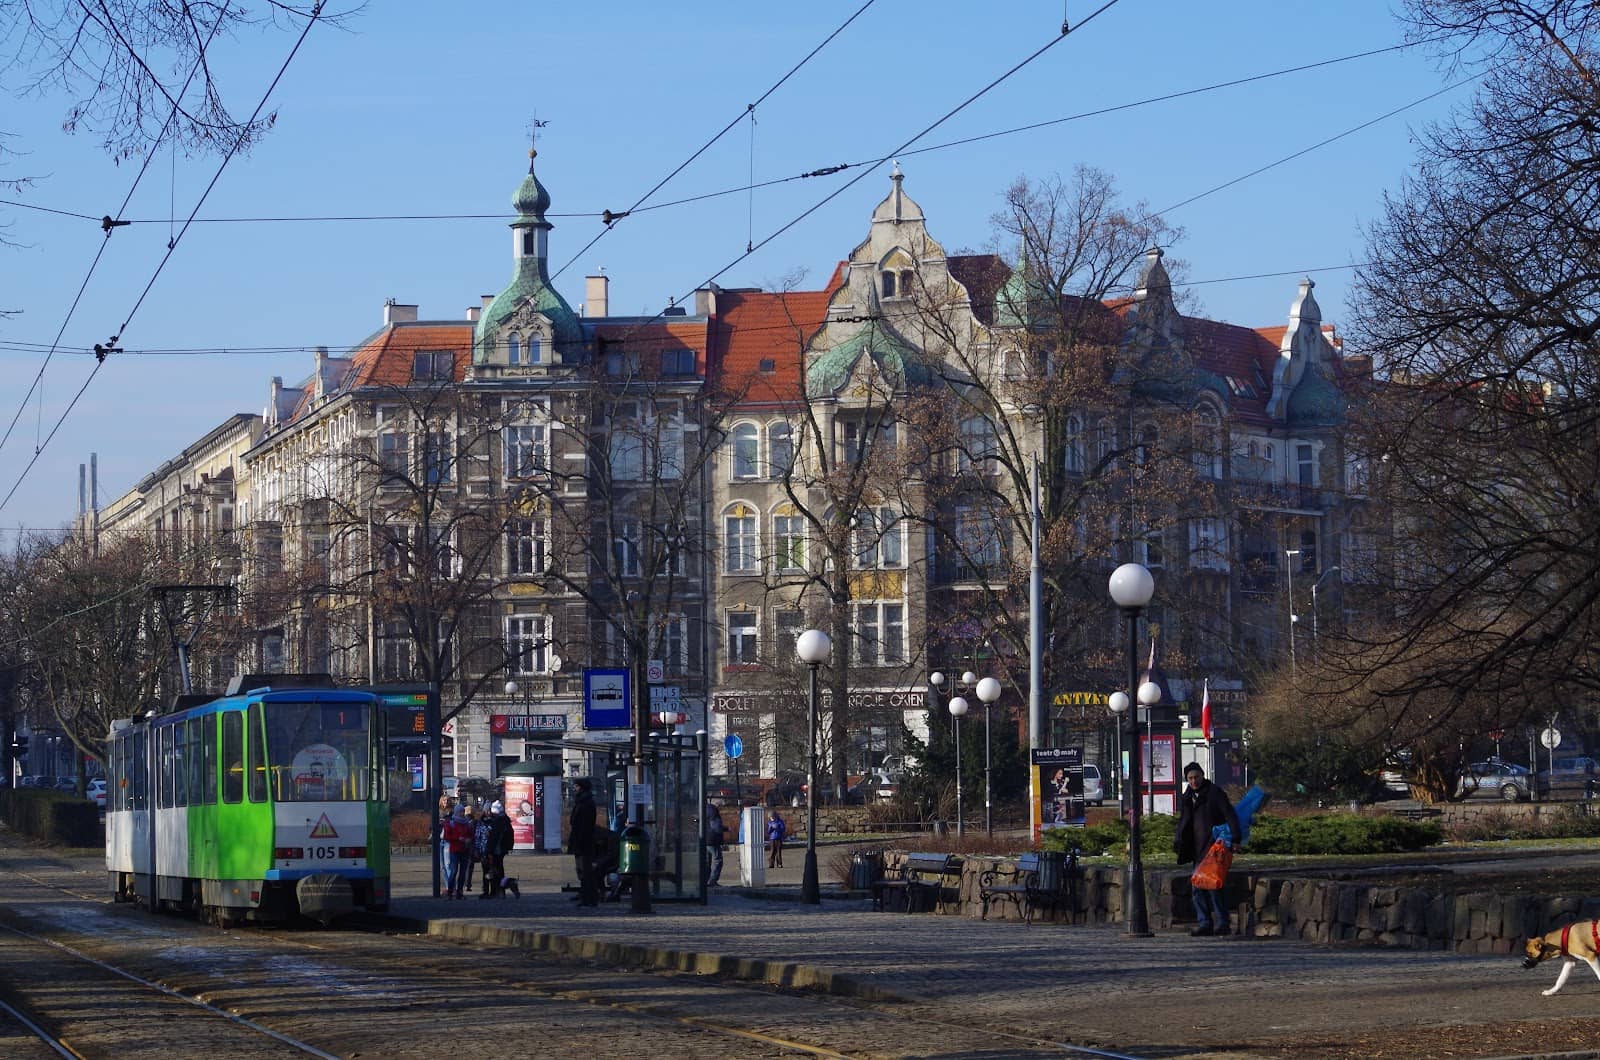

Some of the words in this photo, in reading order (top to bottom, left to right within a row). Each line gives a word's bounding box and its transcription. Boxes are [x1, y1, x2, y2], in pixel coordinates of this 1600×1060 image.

[671, 688, 676, 697] 5
[338, 711, 344, 725] 1
[508, 716, 565, 731] JUBILER
[307, 846, 336, 859] 105
